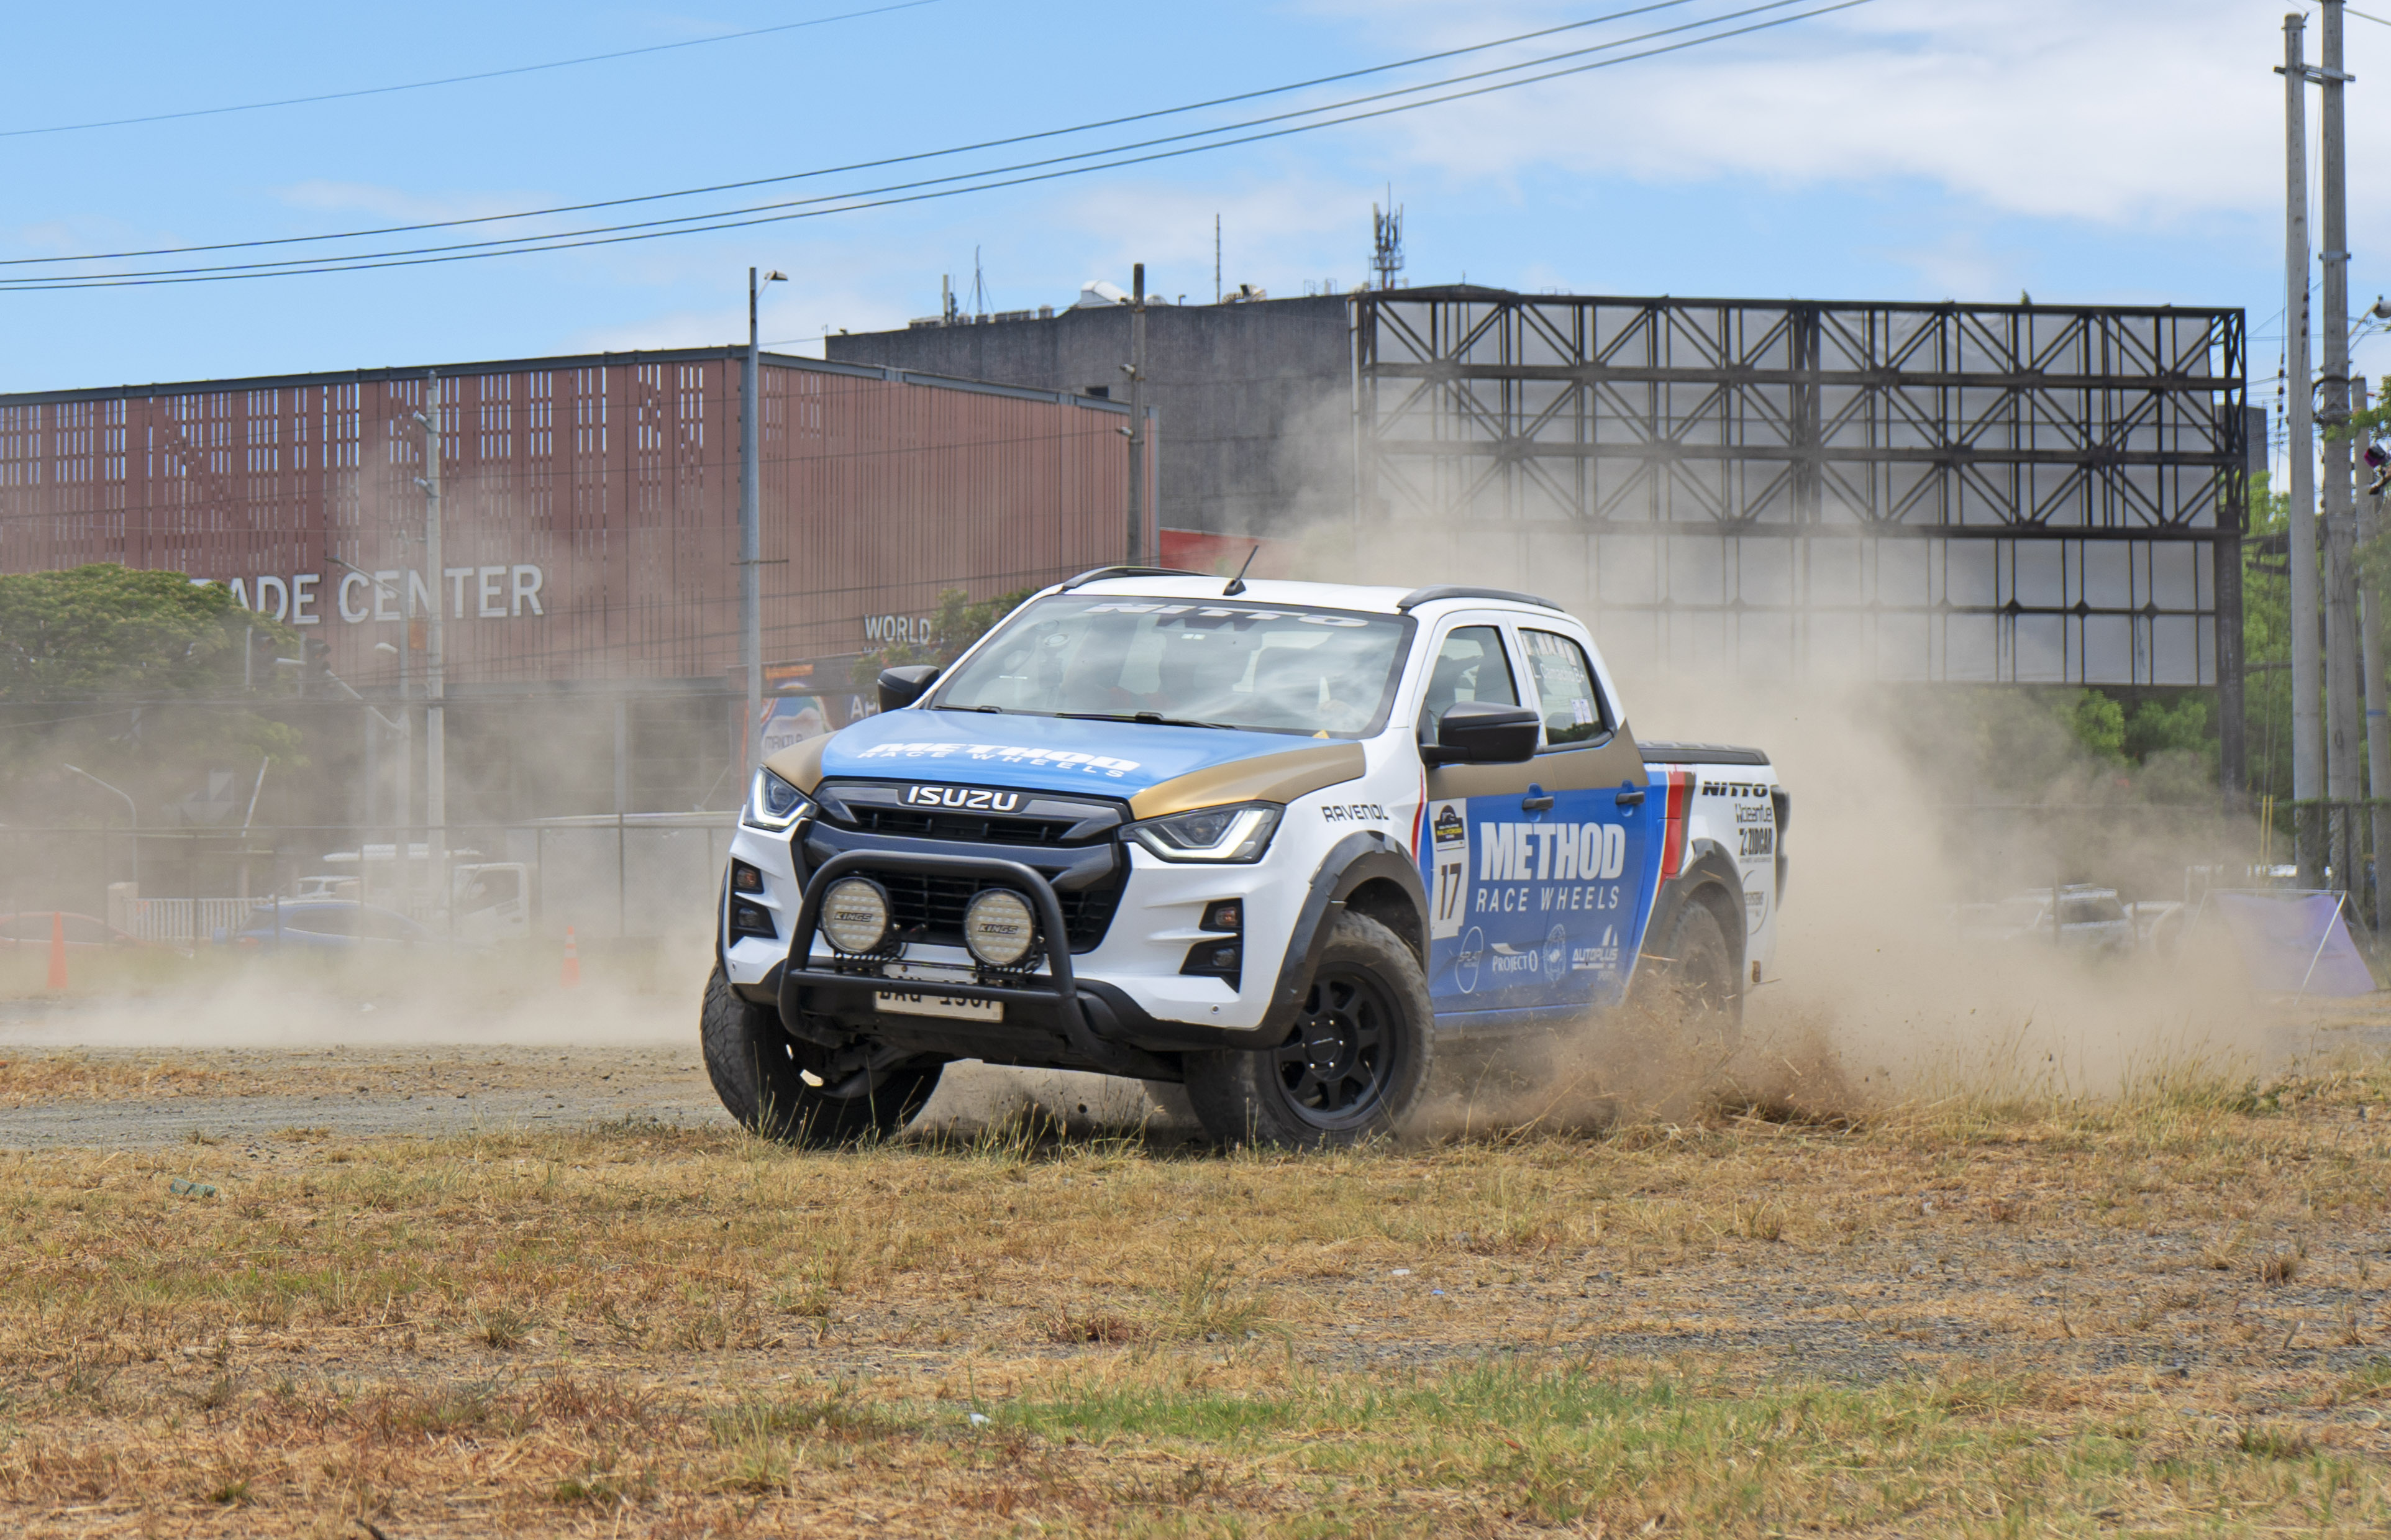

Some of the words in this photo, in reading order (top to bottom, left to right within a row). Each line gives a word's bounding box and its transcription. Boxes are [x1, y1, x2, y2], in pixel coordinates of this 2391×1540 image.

[338, 564, 544, 623] CENTER
[1083, 603, 1369, 627] NITTO
[863, 614, 931, 645] WORLD
[866, 743, 1141, 771] METHOD
[972, 754, 1125, 777] WHEELS
[907, 786, 1019, 811] ISUZU
[1702, 781, 1768, 797] NITTO
[1321, 804, 1390, 822] RAVENOL
[1480, 822, 1625, 880] METHOD
[1439, 863, 1462, 920] 17
[1475, 888, 1529, 912] RACE
[1541, 886, 1619, 911] WHEELS
[834, 912, 872, 923] KINGS
[978, 924, 1018, 934] KINGS
[1572, 948, 1619, 962] AUTOPLUS
